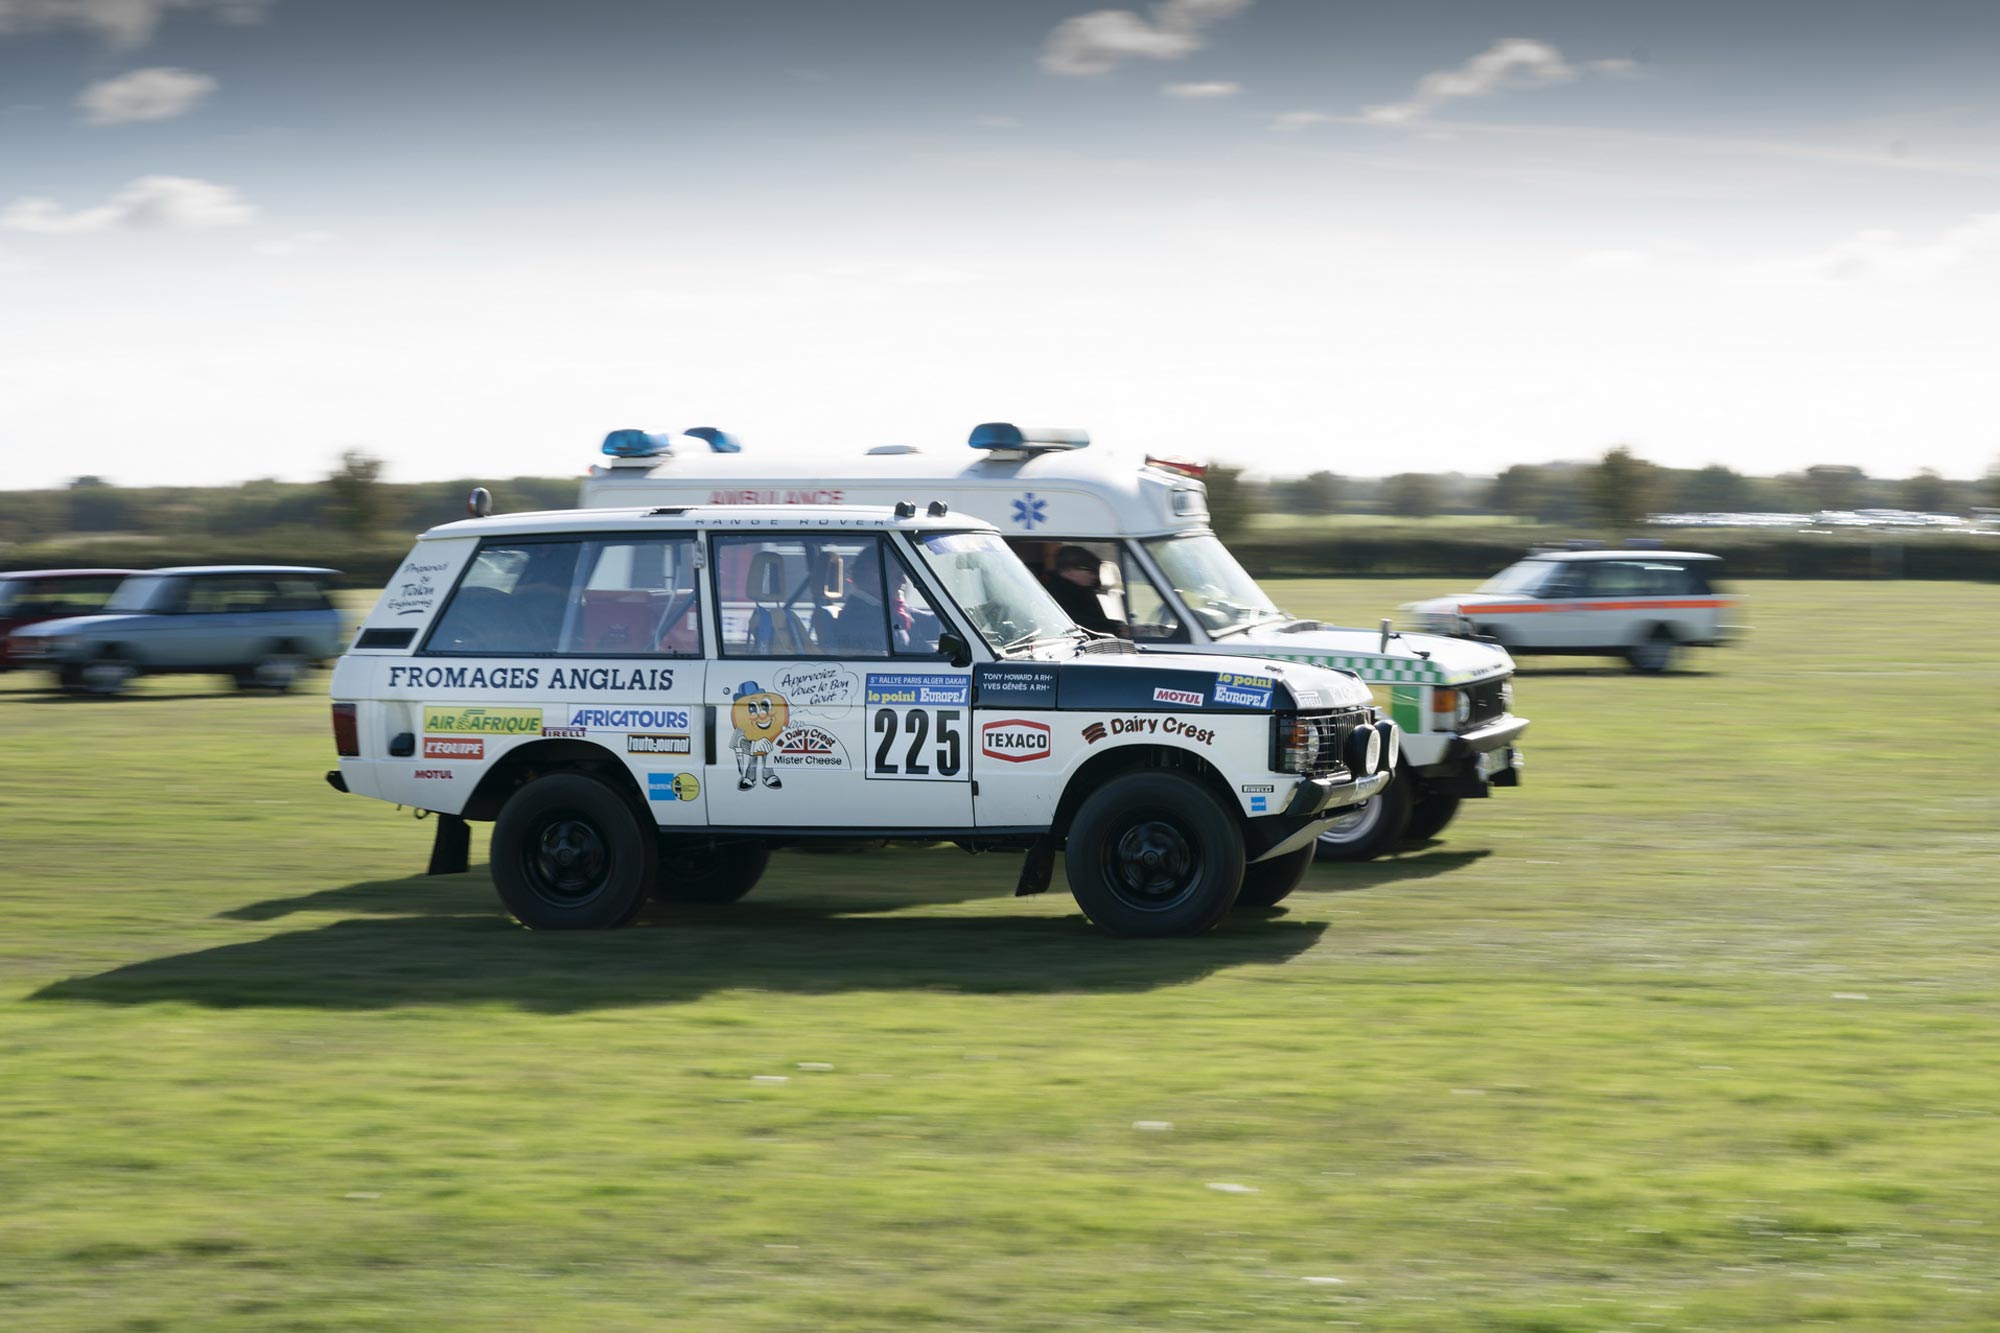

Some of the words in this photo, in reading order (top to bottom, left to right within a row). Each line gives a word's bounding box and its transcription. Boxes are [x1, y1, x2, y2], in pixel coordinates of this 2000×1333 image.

[708, 490, 844, 505] AMBULANCE
[388, 666, 538, 689] FROMAGES
[548, 668, 674, 691] ANGLAIS
[903, 677, 922, 685] PARIS
[923, 677, 944, 685] ALGER
[983, 673, 1003, 681] TONY
[1234, 675, 1272, 688] point
[830, 679, 849, 690] Bon
[982, 682, 1001, 690] YVES
[868, 690, 880, 702] le
[881, 690, 915, 704] point
[1156, 690, 1201, 704] MOTUL
[427, 715, 455, 730] AIR
[469, 716, 540, 732] AFRIQUE
[571, 709, 688, 729] AFRICATOURS
[542, 727, 587, 737] PIRELLI
[1110, 715, 1158, 735] Dairy
[1162, 716, 1215, 745] Crest
[785, 729, 810, 741] Dairy
[810, 729, 836, 747] Crest
[874, 708, 960, 777] 225
[986, 732, 1047, 748] TEXACO
[773, 755, 804, 765] Mister
[805, 755, 842, 766] Cheese
[414, 769, 453, 779] MOTUL
